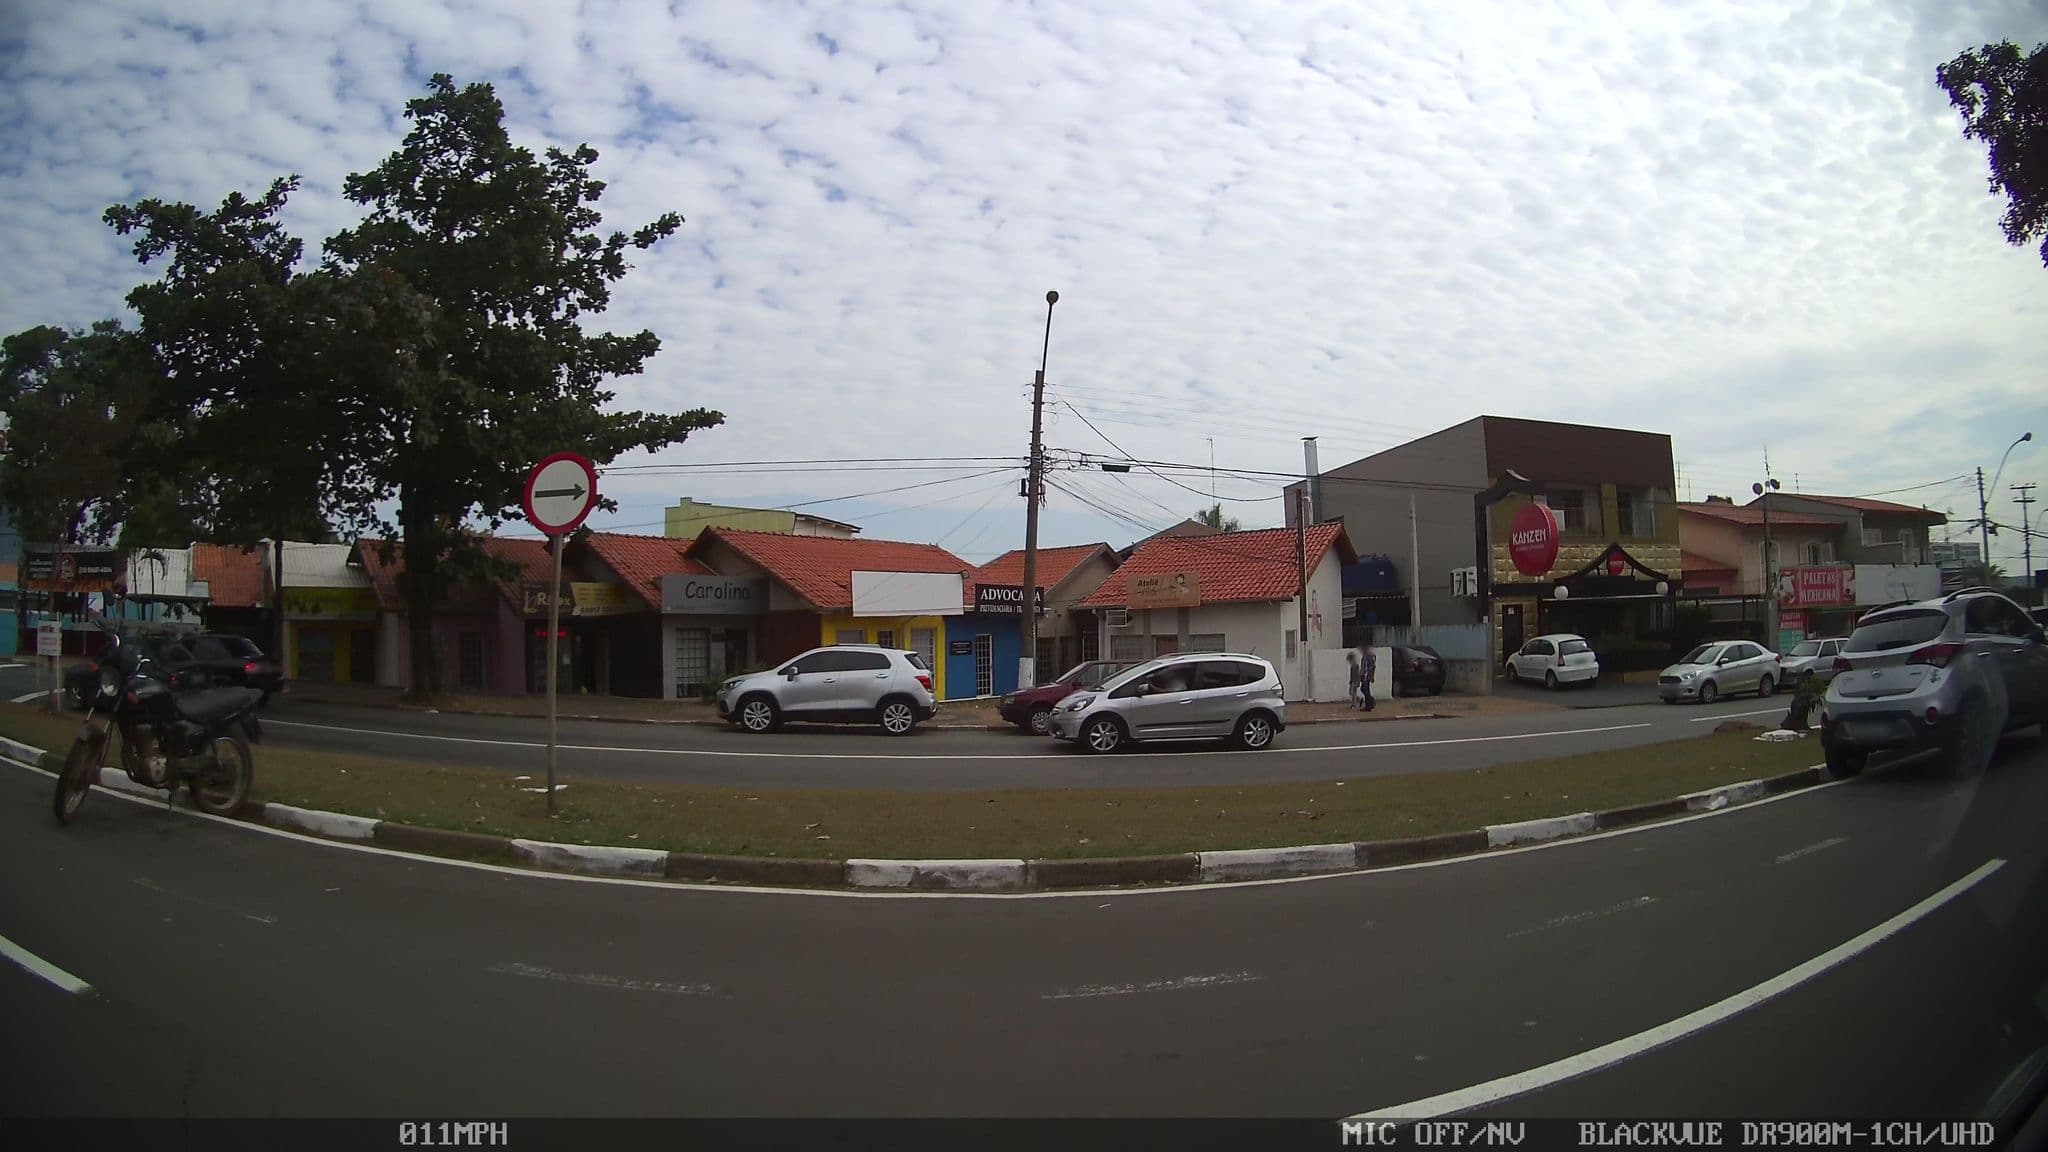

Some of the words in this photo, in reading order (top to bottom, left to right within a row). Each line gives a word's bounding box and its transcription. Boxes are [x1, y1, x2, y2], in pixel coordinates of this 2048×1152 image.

[1512, 528, 1546, 546] KANZEN
[1803, 571, 1836, 585] PALETAS
[685, 581, 751, 600] Carolina
[980, 588, 1041, 602] ADVOCAA
